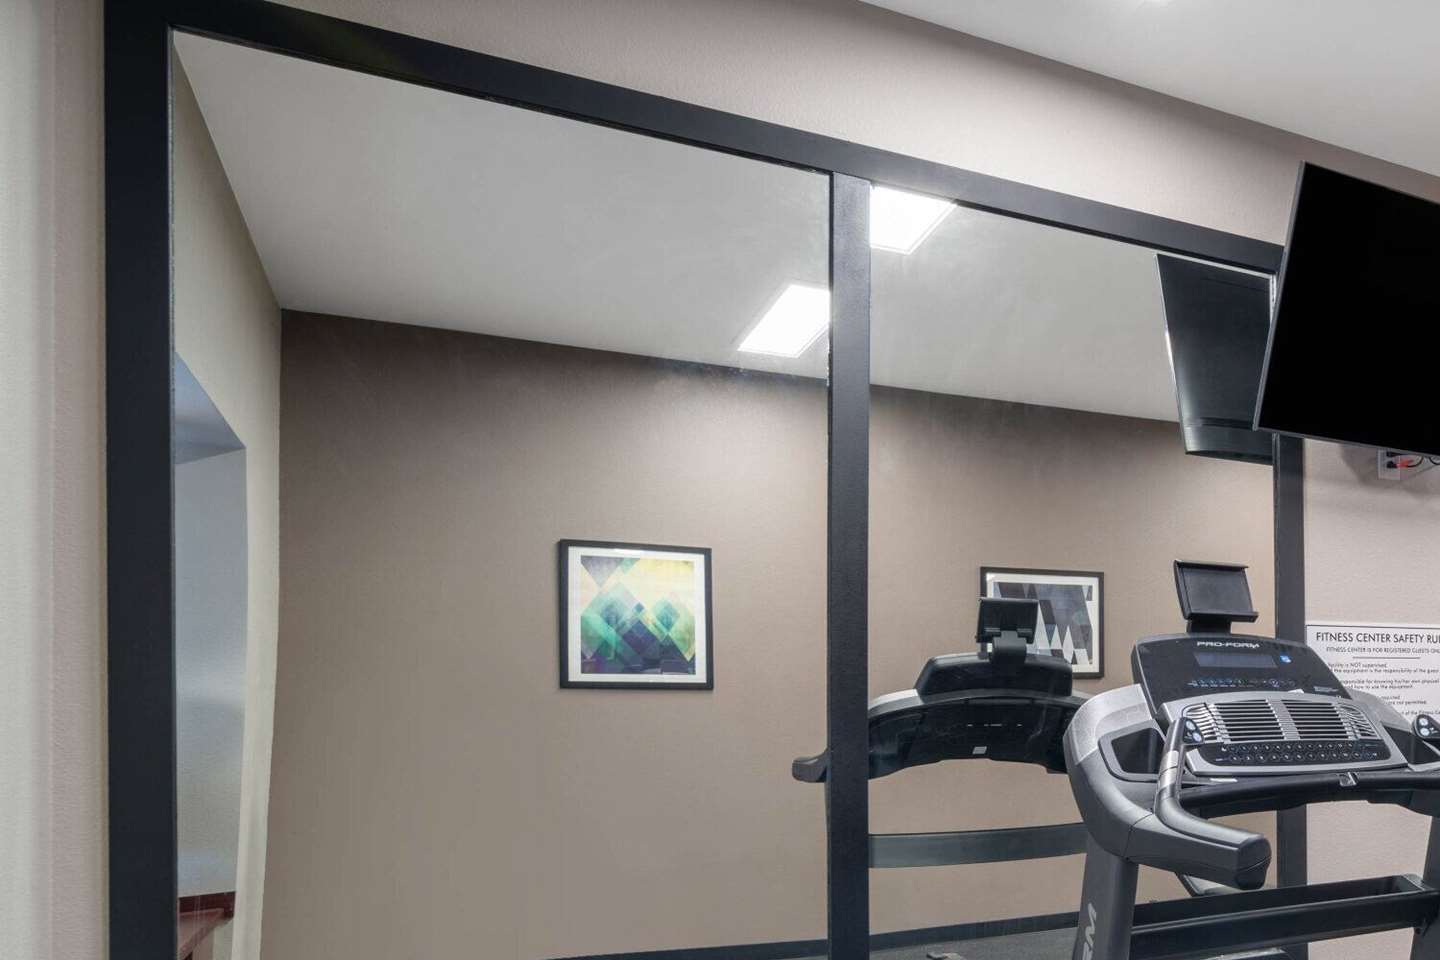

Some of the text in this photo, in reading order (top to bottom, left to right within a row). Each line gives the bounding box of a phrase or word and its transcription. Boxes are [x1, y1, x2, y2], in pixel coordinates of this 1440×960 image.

[1316, 632, 1353, 642] FITNESS
[1356, 632, 1390, 643] CENTER
[1393, 633, 1424, 643] SAFETY
[1197, 641, 1260, 649] PRO-FORM
